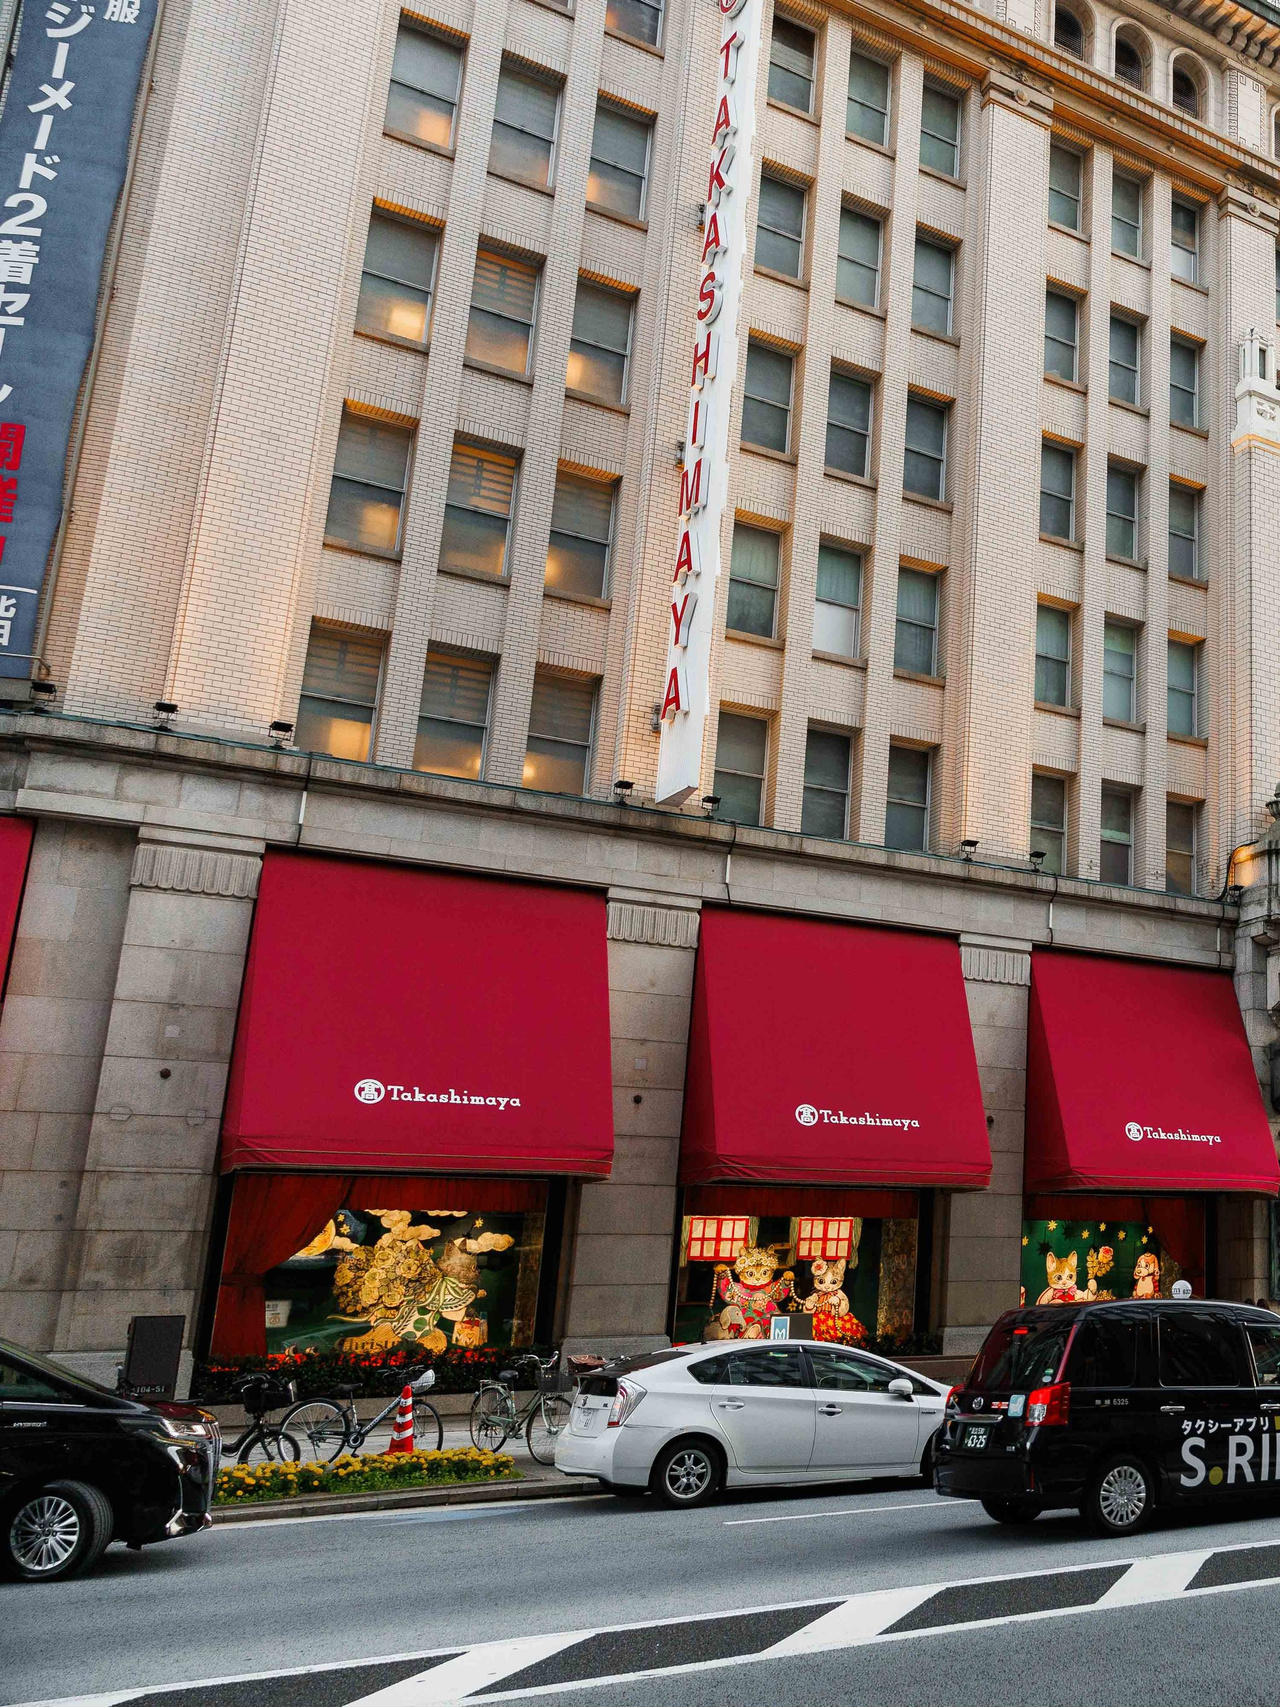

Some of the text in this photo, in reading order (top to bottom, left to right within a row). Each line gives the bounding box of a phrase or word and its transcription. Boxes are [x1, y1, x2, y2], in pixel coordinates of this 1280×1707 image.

[661, 30, 742, 722] TAKASHIMAYA
[387, 1085, 521, 1110] Takashimaya
[819, 1110, 920, 1130] Takashimaya
[1143, 1127, 1222, 1145] Takashimaya
[1181, 1416, 1270, 1435] タクシーアプリ
[967, 1434, 988, 1448] 63-25
